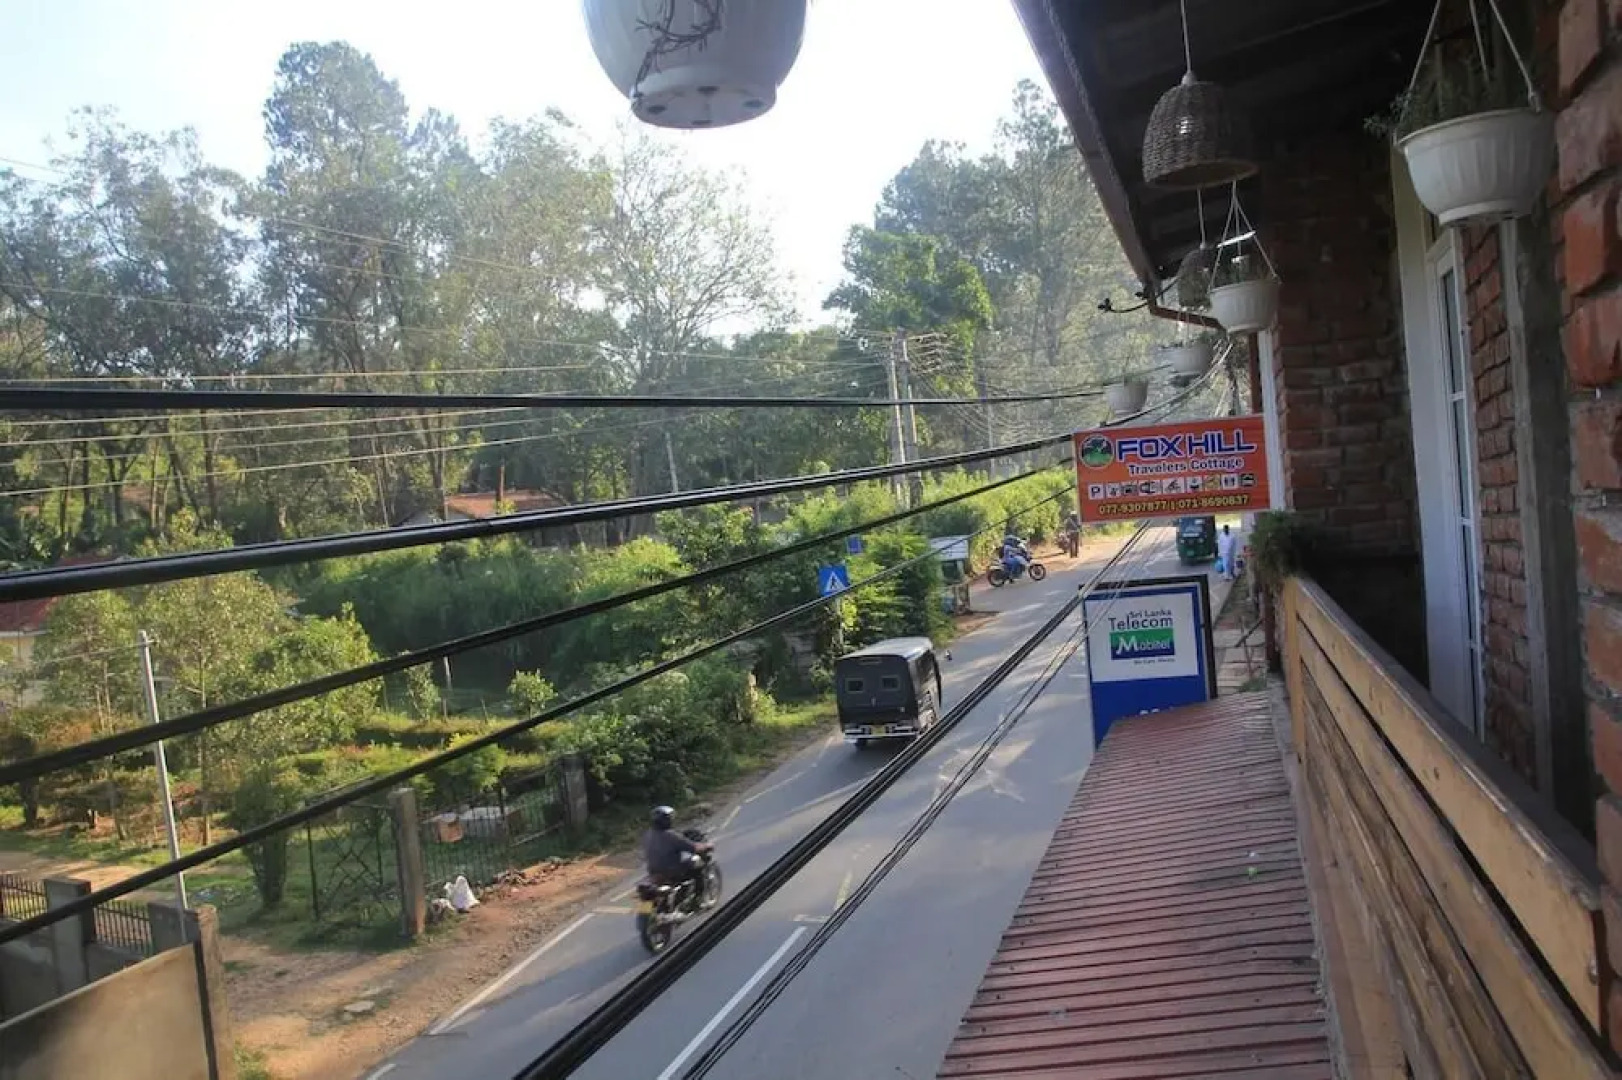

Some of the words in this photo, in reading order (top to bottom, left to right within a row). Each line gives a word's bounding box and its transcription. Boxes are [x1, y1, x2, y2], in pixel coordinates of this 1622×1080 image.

[1117, 435, 1184, 461] FOX
[1187, 430, 1256, 455] HILL
[1129, 462, 1186, 475] Travelers
[1191, 457, 1244, 472] Cottage
[1129, 610, 1142, 618] Sri
[1144, 609, 1171, 617] Lanka
[1108, 616, 1173, 630] Telecom
[1116, 635, 1170, 655] Mobitel
